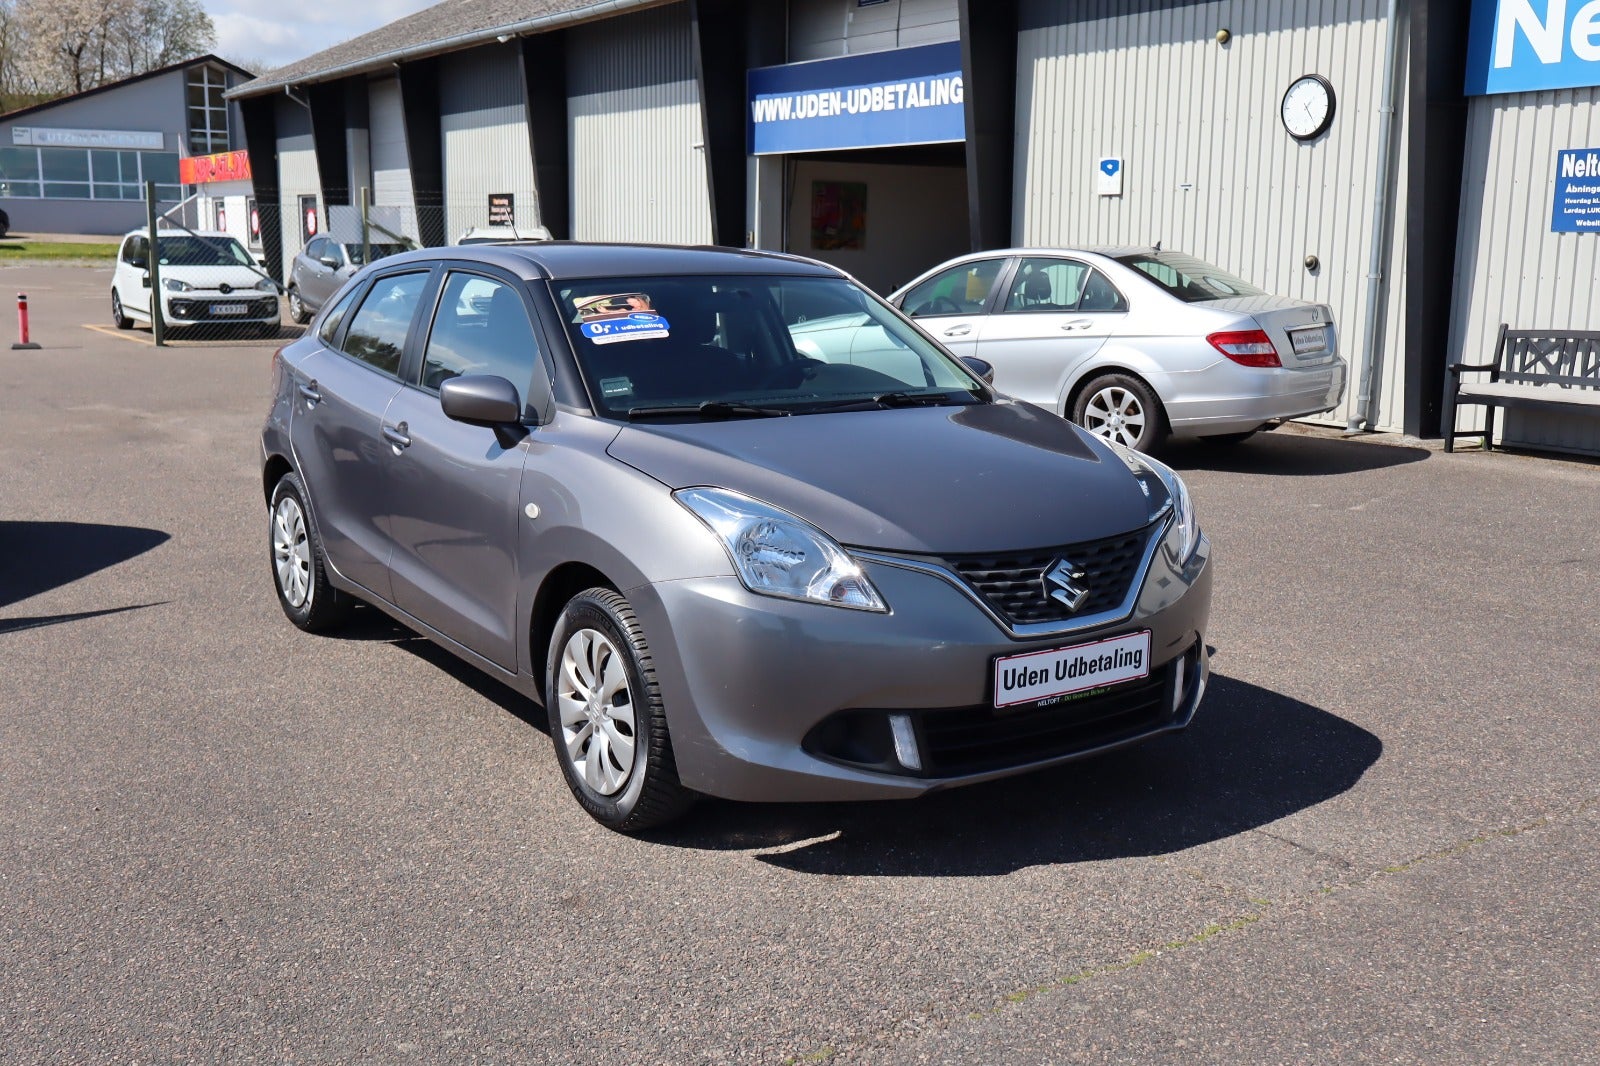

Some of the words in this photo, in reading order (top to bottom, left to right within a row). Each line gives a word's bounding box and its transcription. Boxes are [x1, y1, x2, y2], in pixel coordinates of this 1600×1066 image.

[1494, 0, 1600, 68] Ne
[752, 76, 964, 123] WWW.UDEN-UDBETALING
[1003, 666, 1049, 691] Uden
[1054, 648, 1143, 681] Udbetaling
[1037, 696, 1061, 707] NELTOFT
